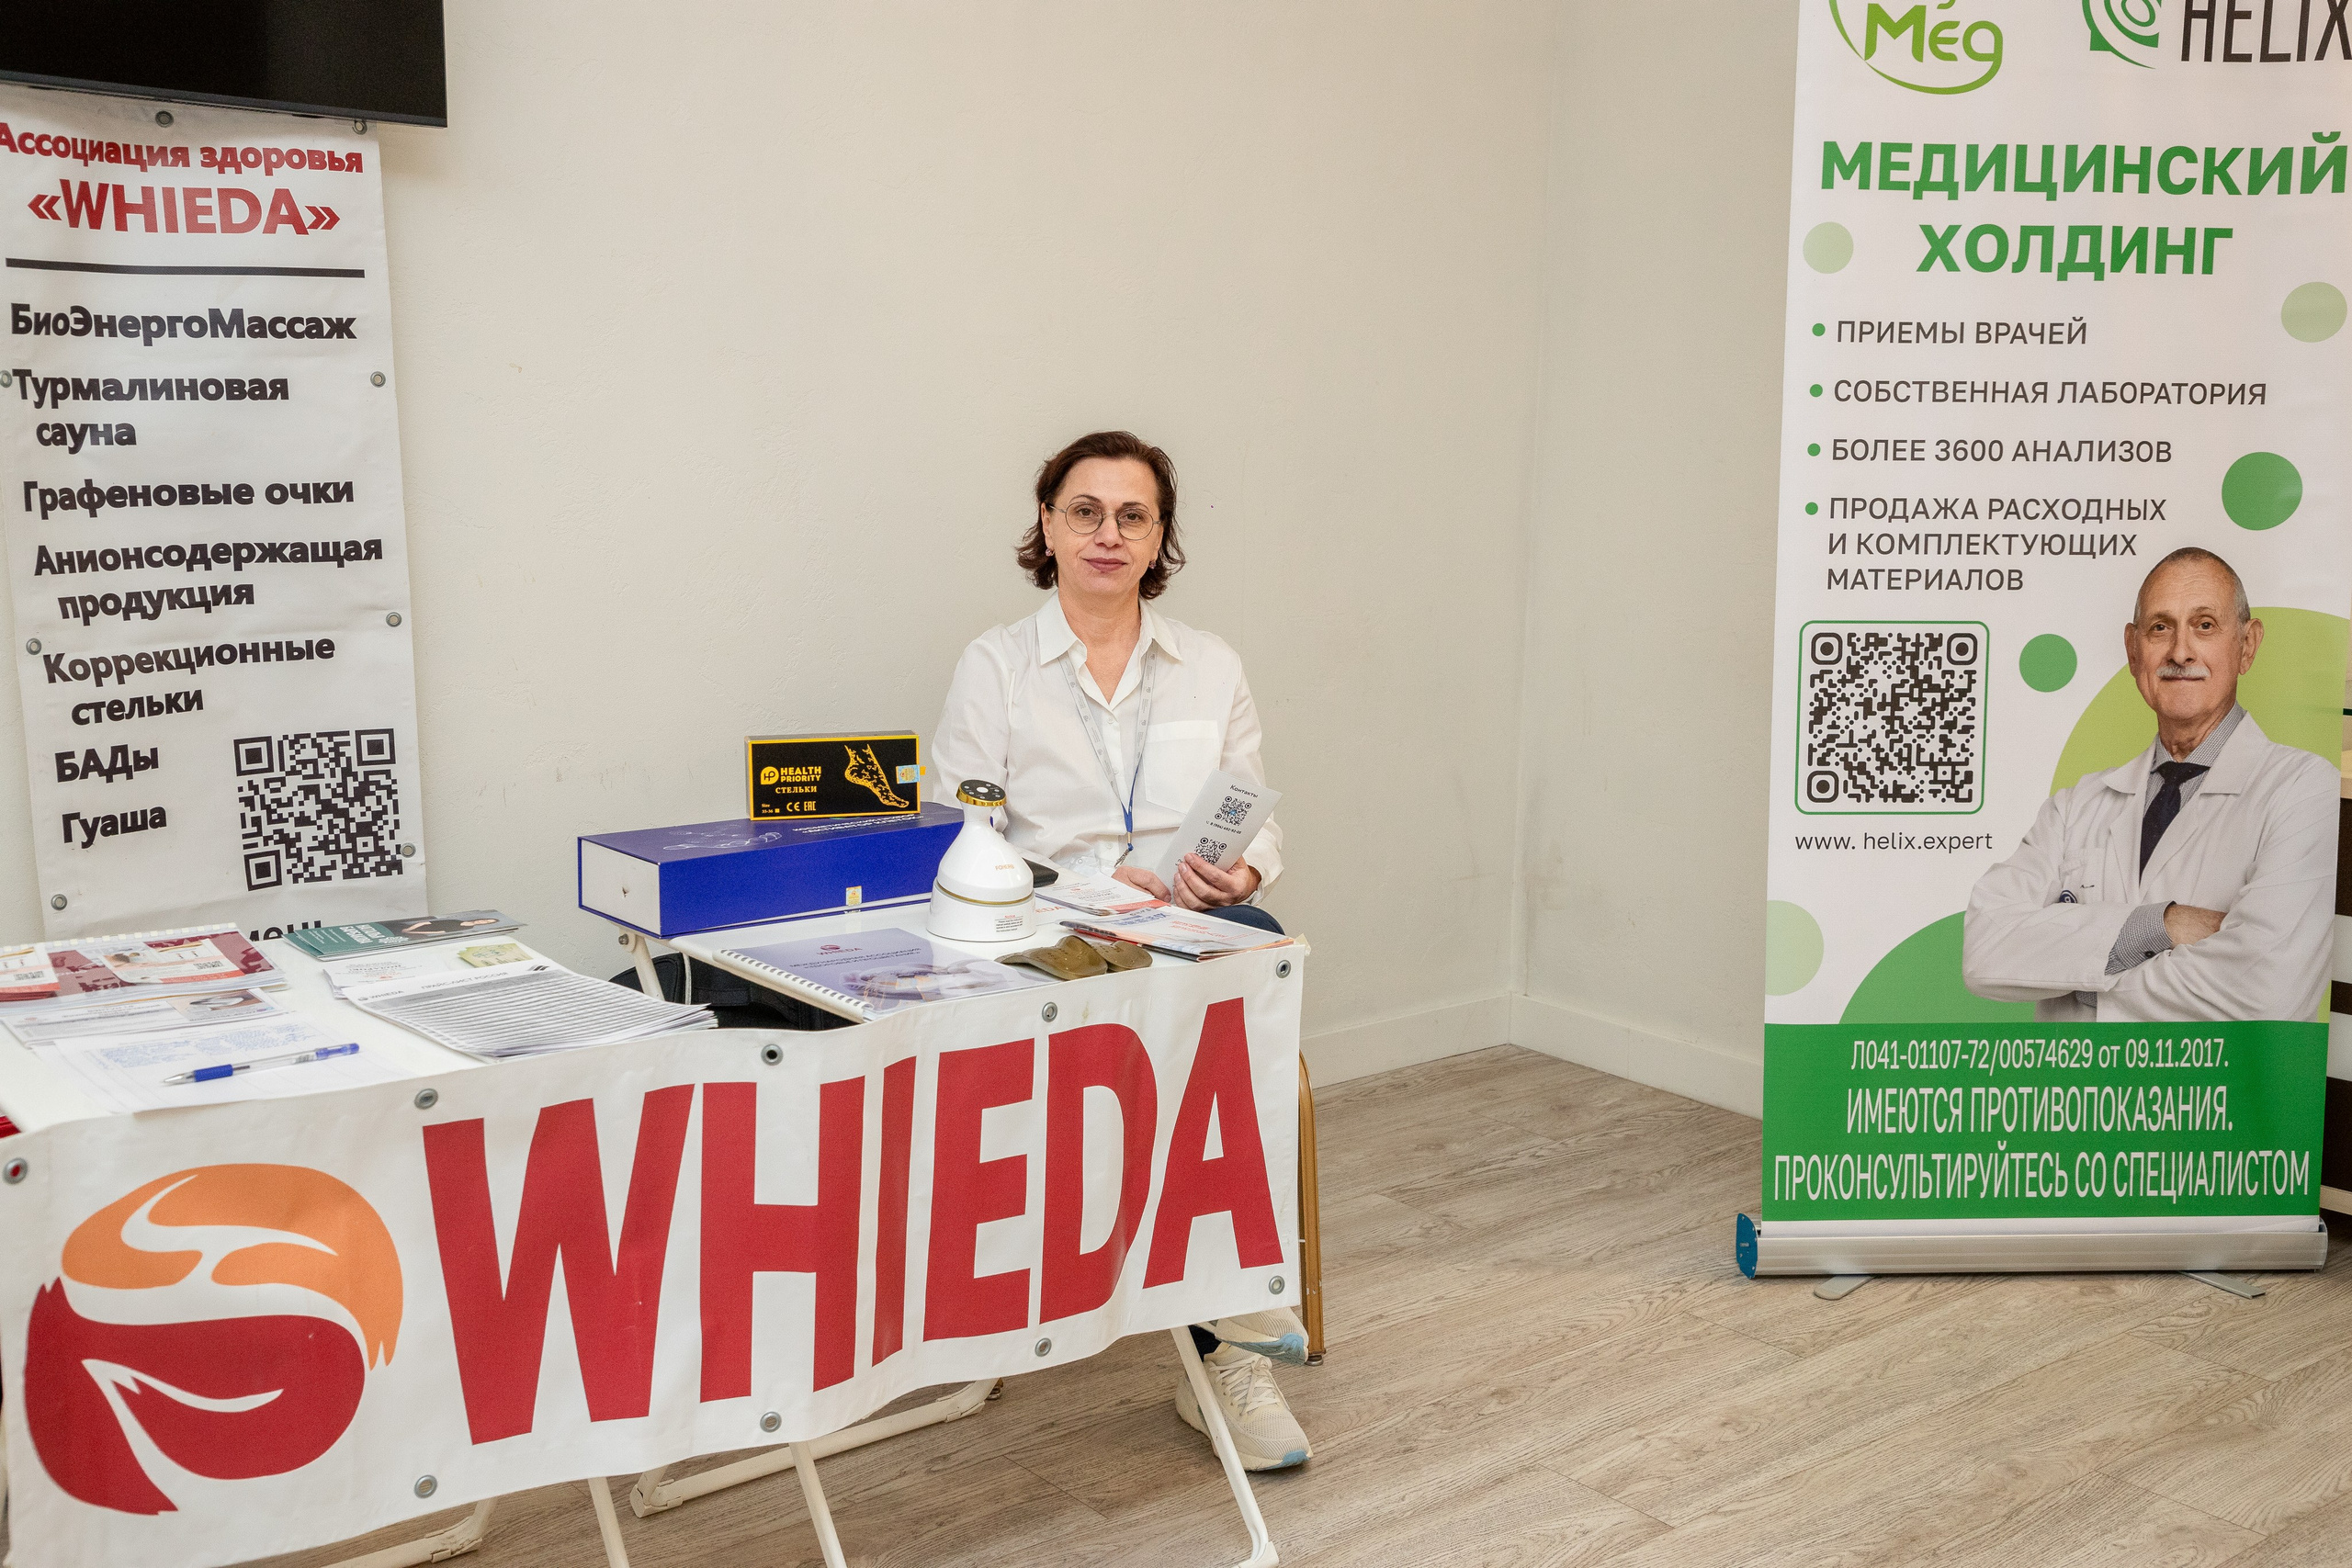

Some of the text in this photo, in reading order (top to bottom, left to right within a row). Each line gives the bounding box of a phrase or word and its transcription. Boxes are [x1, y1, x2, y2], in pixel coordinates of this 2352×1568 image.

[2181, 0, 2352, 62] HELIX
[0, 122, 364, 176] Ассоциация здоровья
[1821, 130, 2348, 202] МЕДИЦИНСКИЙ
[27, 178, 341, 236] «WHIEDA»
[1916, 223, 2233, 282] ХОЛДИНГ
[10, 302, 357, 347] БиоЭнергоМассаж
[1837, 316, 2087, 344] ПРИЕМЫ ВРАЧЕЙ
[11, 367, 290, 410] Турмалиновая
[1834, 379, 2267, 405] СОБСТВЕННАЯ ЛАБОРАТОРИЯ
[36, 423, 137, 456] сауна
[1832, 438, 2172, 463] БОЛЕЕ 3600 АНАЛИЗОВ
[23, 478, 355, 521] Графеновые очки
[1829, 497, 2167, 525] ПРОДАЖА РАСХОДНЫХ
[34, 538, 383, 577] Анионсодержащая
[1828, 533, 2138, 559] И КОМПЛЕКТУЮЩИХ
[1827, 568, 2024, 592] МАТЕРИАЛОВ
[57, 583, 254, 626] продукция
[42, 637, 335, 688] Коррекционные
[71, 689, 204, 726] стельки
[54, 743, 159, 784] БАДы
[780, 766, 821, 776] HEALTH
[780, 774, 821, 783] PRIORITY
[775, 785, 818, 794] СТЕЛЬКИ
[1229, 784, 1259, 798] Контакты
[62, 806, 167, 848] Гуаша
[1794, 831, 1993, 854] www. helix.expert
[1850, 1037, 2229, 1077] Л041-01107-72/00574629 от 09.11.2017.
[1847, 1085, 2233, 1134] ИМЕЮТСЯ ПРОТИВОПОКАЗАНИЯ.
[1774, 1140, 2310, 1204] ПРОКОНСУЛЬТИРУЙТЕСЬ СО СПЕЦИАЛИСТОМ
[422, 995, 1283, 1445] WHIEDA
